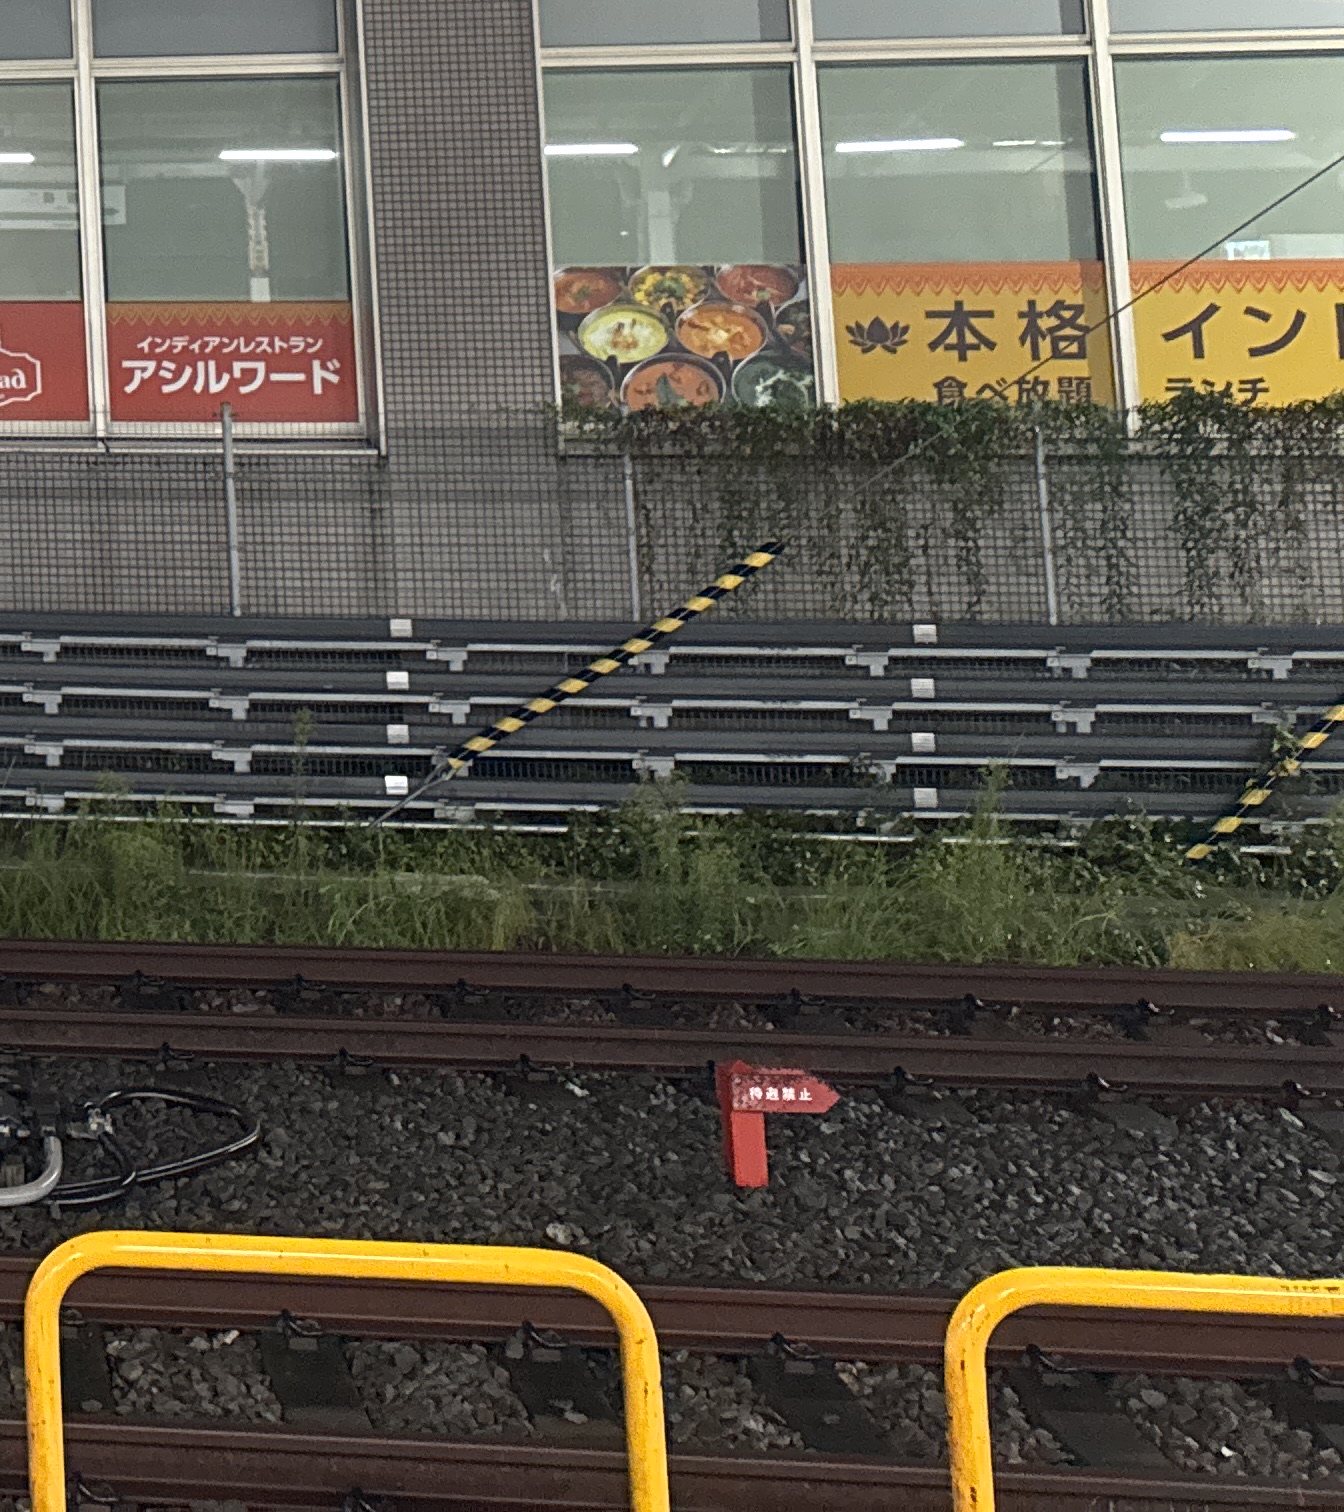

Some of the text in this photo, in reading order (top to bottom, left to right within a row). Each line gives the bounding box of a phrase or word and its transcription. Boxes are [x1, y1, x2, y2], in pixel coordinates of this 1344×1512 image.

[137, 336, 324, 355] インディアンレストラン
[121, 359, 341, 395] アシルワード
